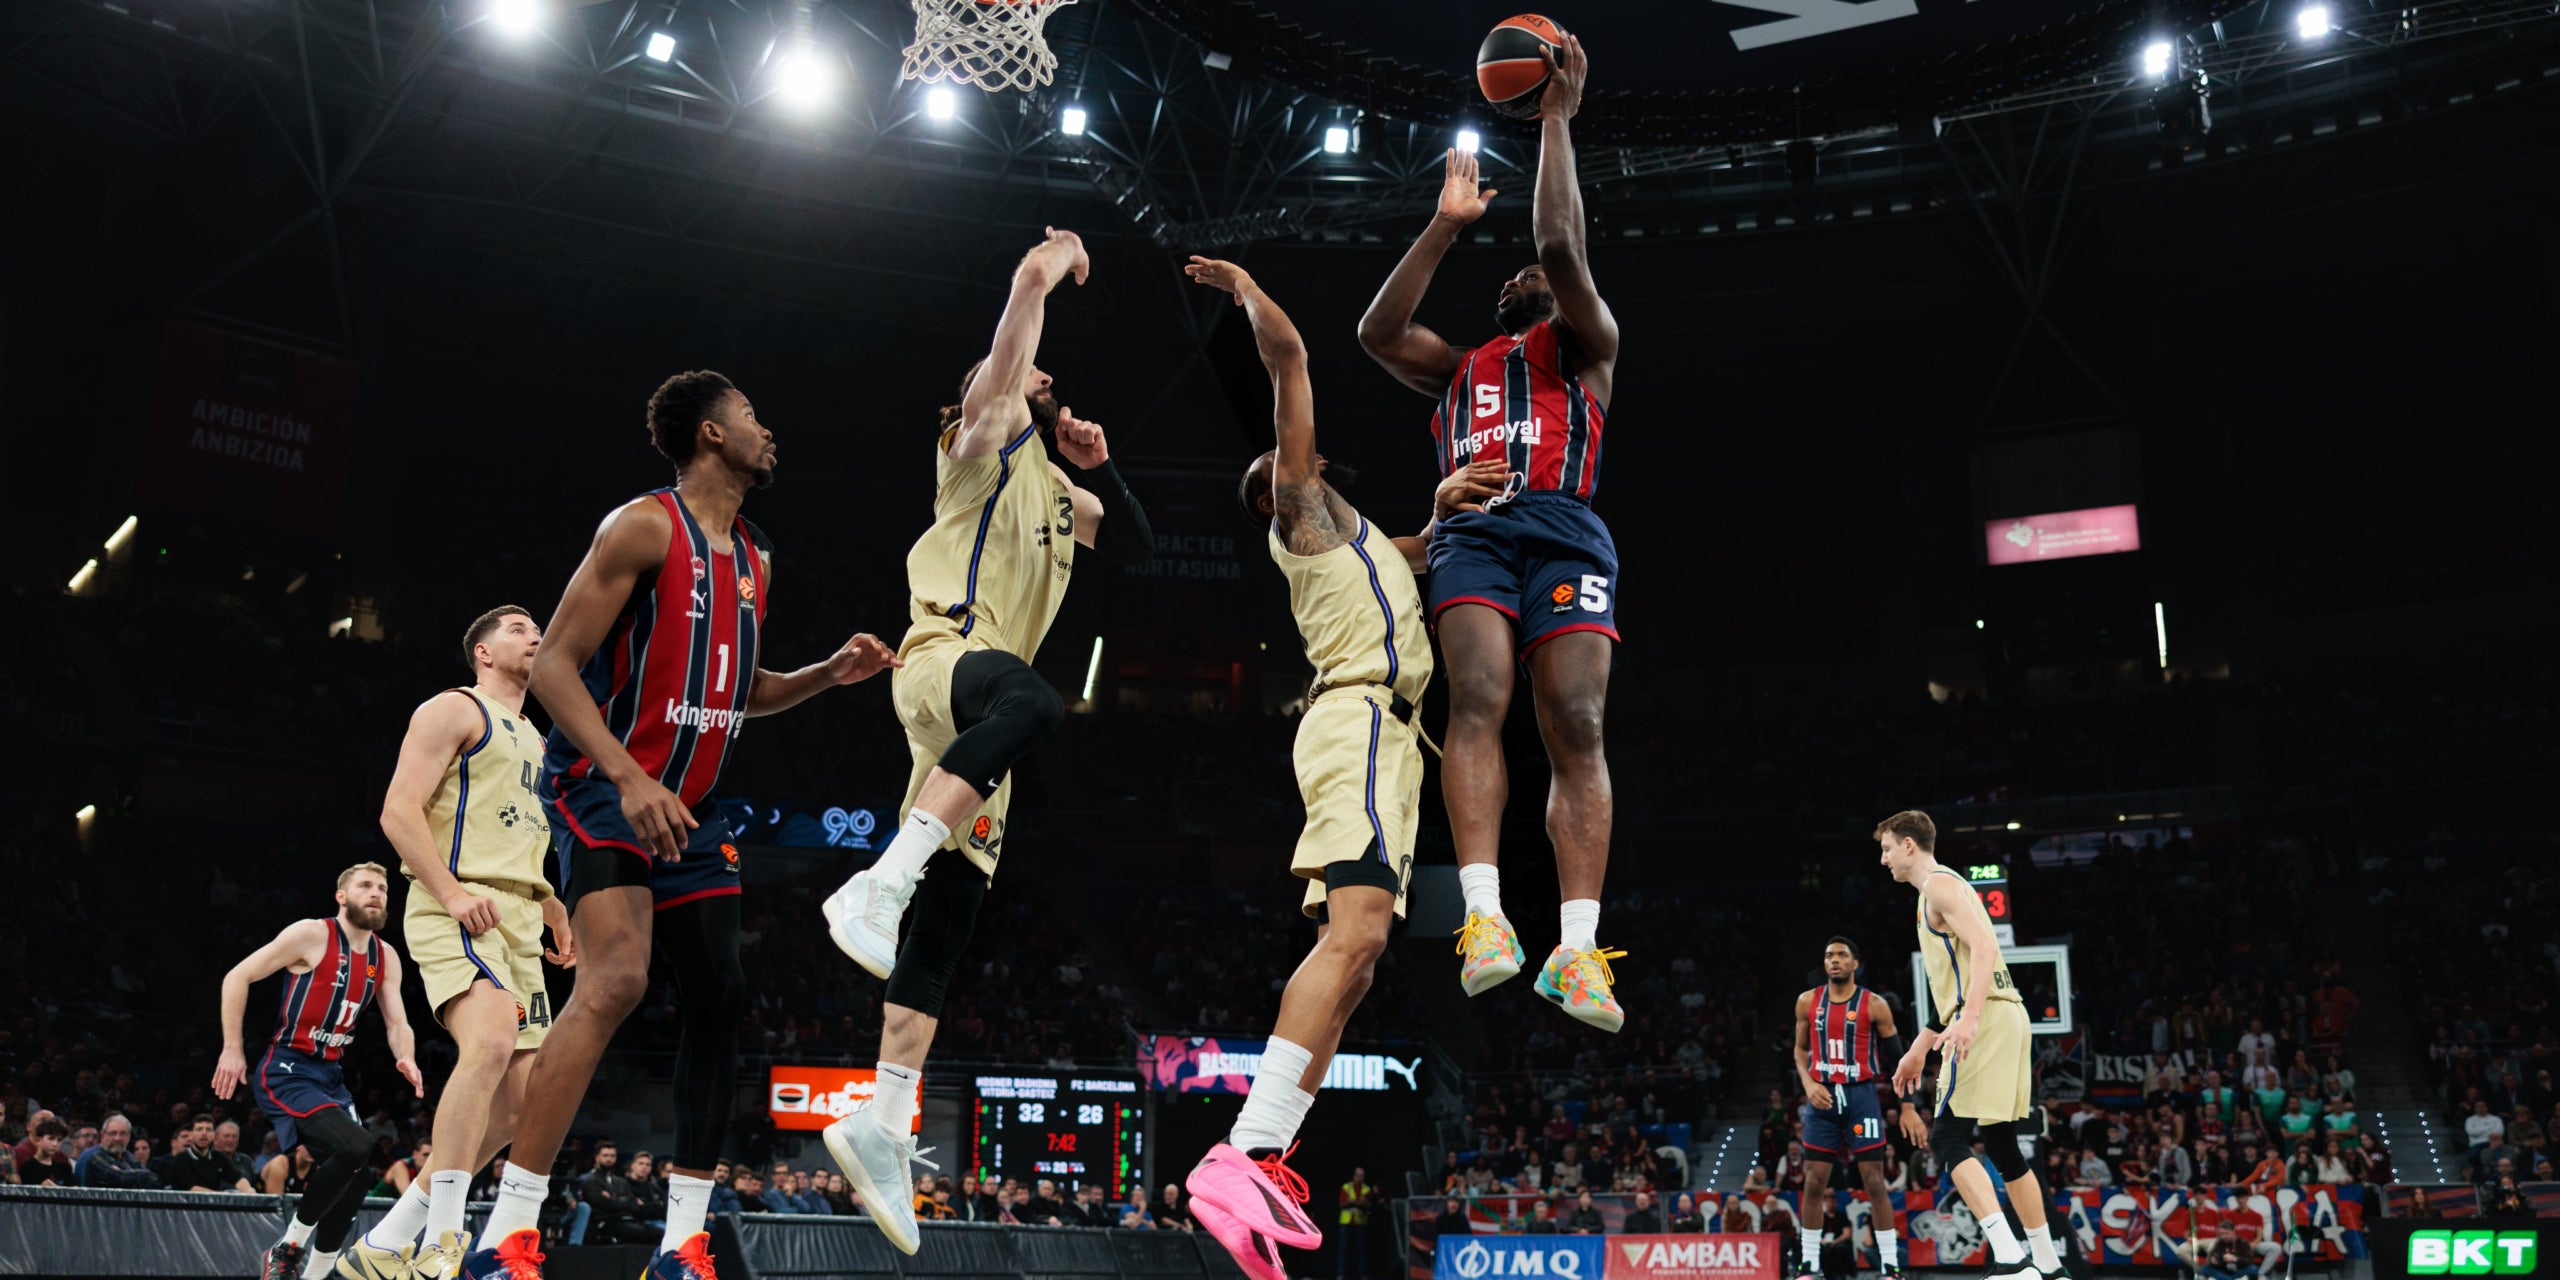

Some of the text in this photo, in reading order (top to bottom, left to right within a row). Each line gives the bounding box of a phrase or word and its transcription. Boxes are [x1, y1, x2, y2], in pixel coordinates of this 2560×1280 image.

[1475, 384, 1500, 418] 5
[191, 397, 312, 444] AMBICIÓN
[190, 426, 304, 471] ANBIZIOA
[1453, 418, 1541, 459] ingroyal
[1579, 574, 1608, 614] 5
[715, 643, 730, 693] 1
[664, 697, 748, 739] kingroya
[1969, 864, 2000, 880] 7:42
[335, 999, 361, 1027] 17
[529, 991, 550, 1029] 4
[1828, 1038, 1845, 1060] 11
[1815, 1060, 1860, 1077] kingroyal
[1018, 1103, 1045, 1123] 32
[1077, 1104, 1104, 1124] 26
[1863, 1117, 1880, 1139] 11
[1046, 1132, 1077, 1152] 7:42
[1492, 1249, 1583, 1280] IMQ
[1648, 1241, 1762, 1269] AMBAR
[2411, 1238, 2534, 1267] BKT
